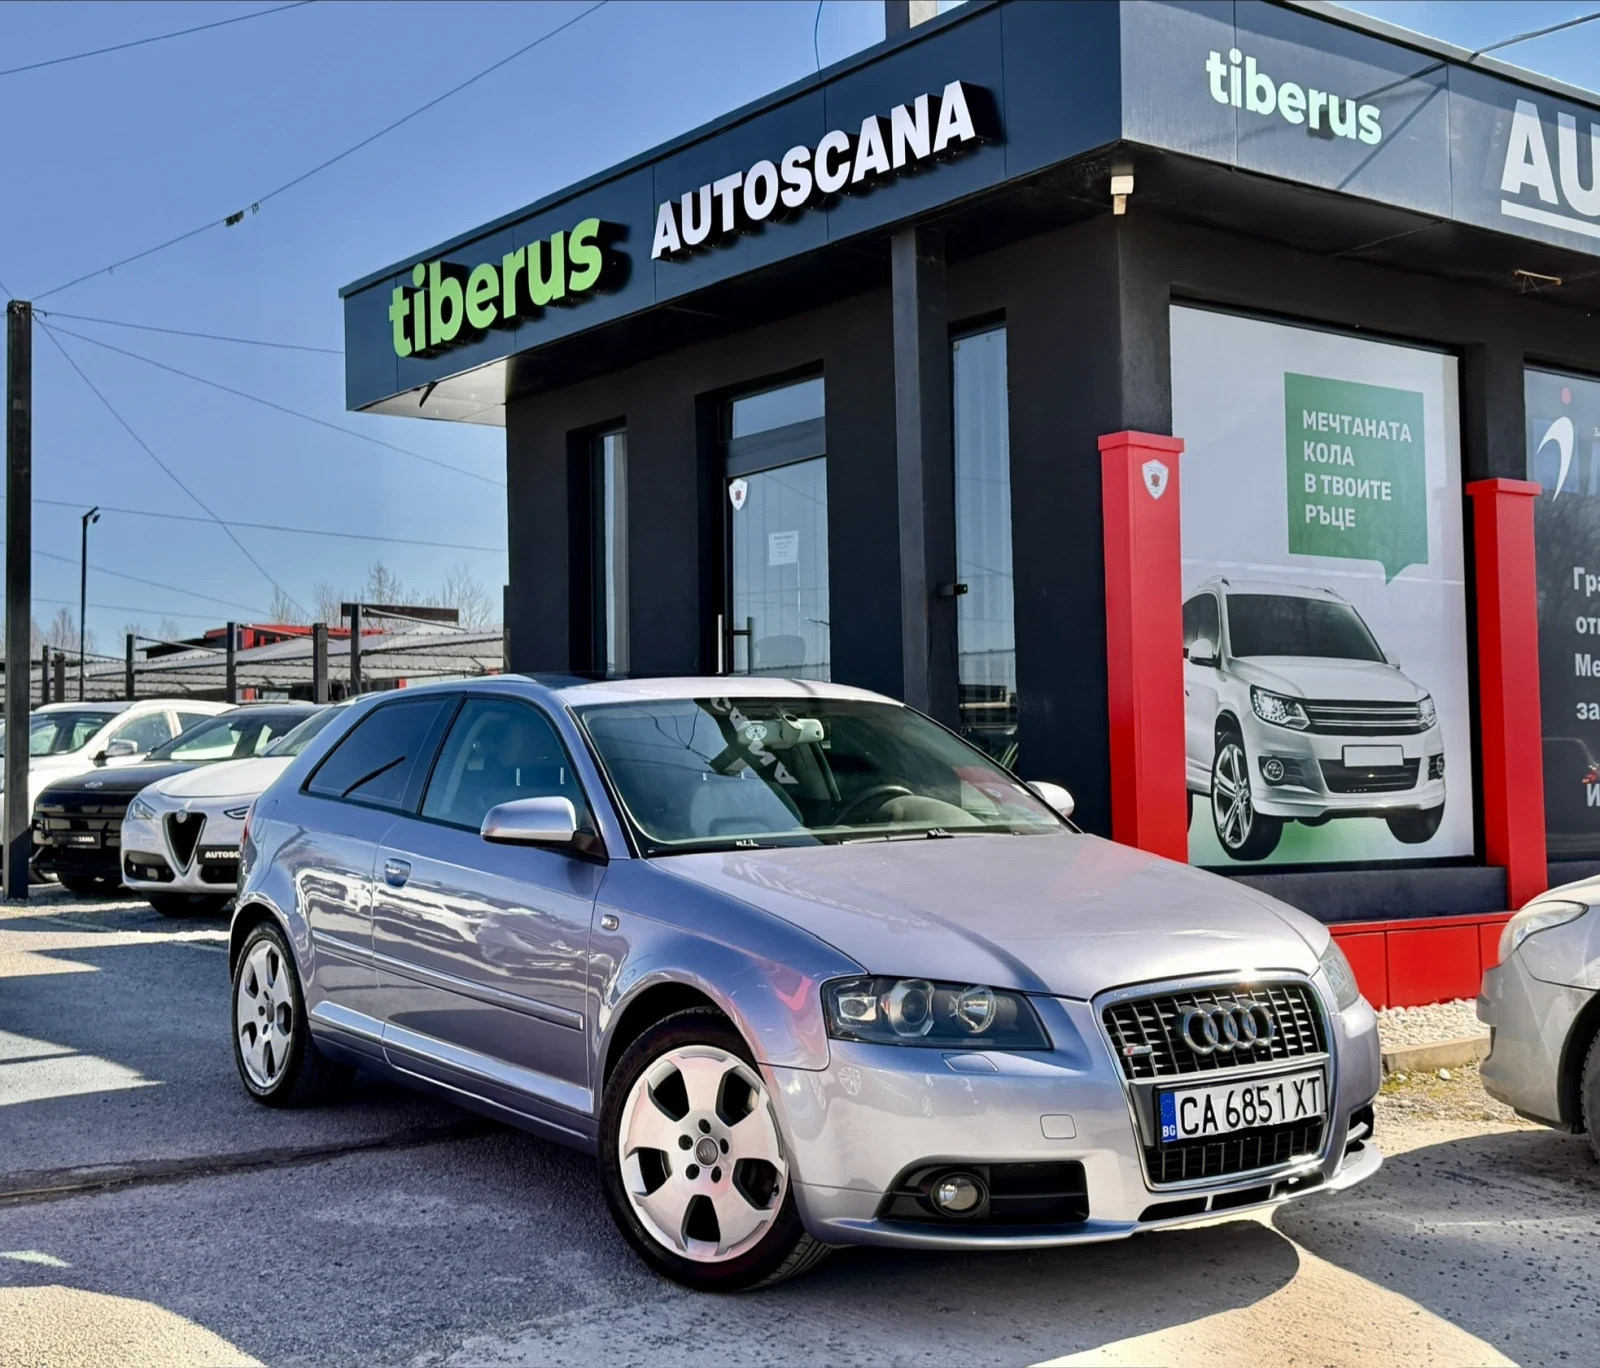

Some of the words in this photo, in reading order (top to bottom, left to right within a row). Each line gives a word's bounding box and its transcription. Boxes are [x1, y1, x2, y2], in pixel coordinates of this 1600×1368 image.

[1206, 48, 1382, 145] tiberus
[651, 80, 976, 260] AUTOSCANA
[389, 217, 603, 358] tiberus
[1302, 409, 1413, 443] МЕЧТАНАТА
[1303, 440, 1356, 467] КОЛА
[1304, 472, 1317, 493] В
[1320, 474, 1392, 501] ТВОИТЕ
[1305, 503, 1356, 531] РЪЦЕ
[1573, 566, 1600, 597] Гр
[1180, 1093, 1219, 1135] CA
[1225, 1085, 1286, 1129] 6851
[1292, 1075, 1321, 1118] XT
[1162, 1125, 1176, 1138] BG
